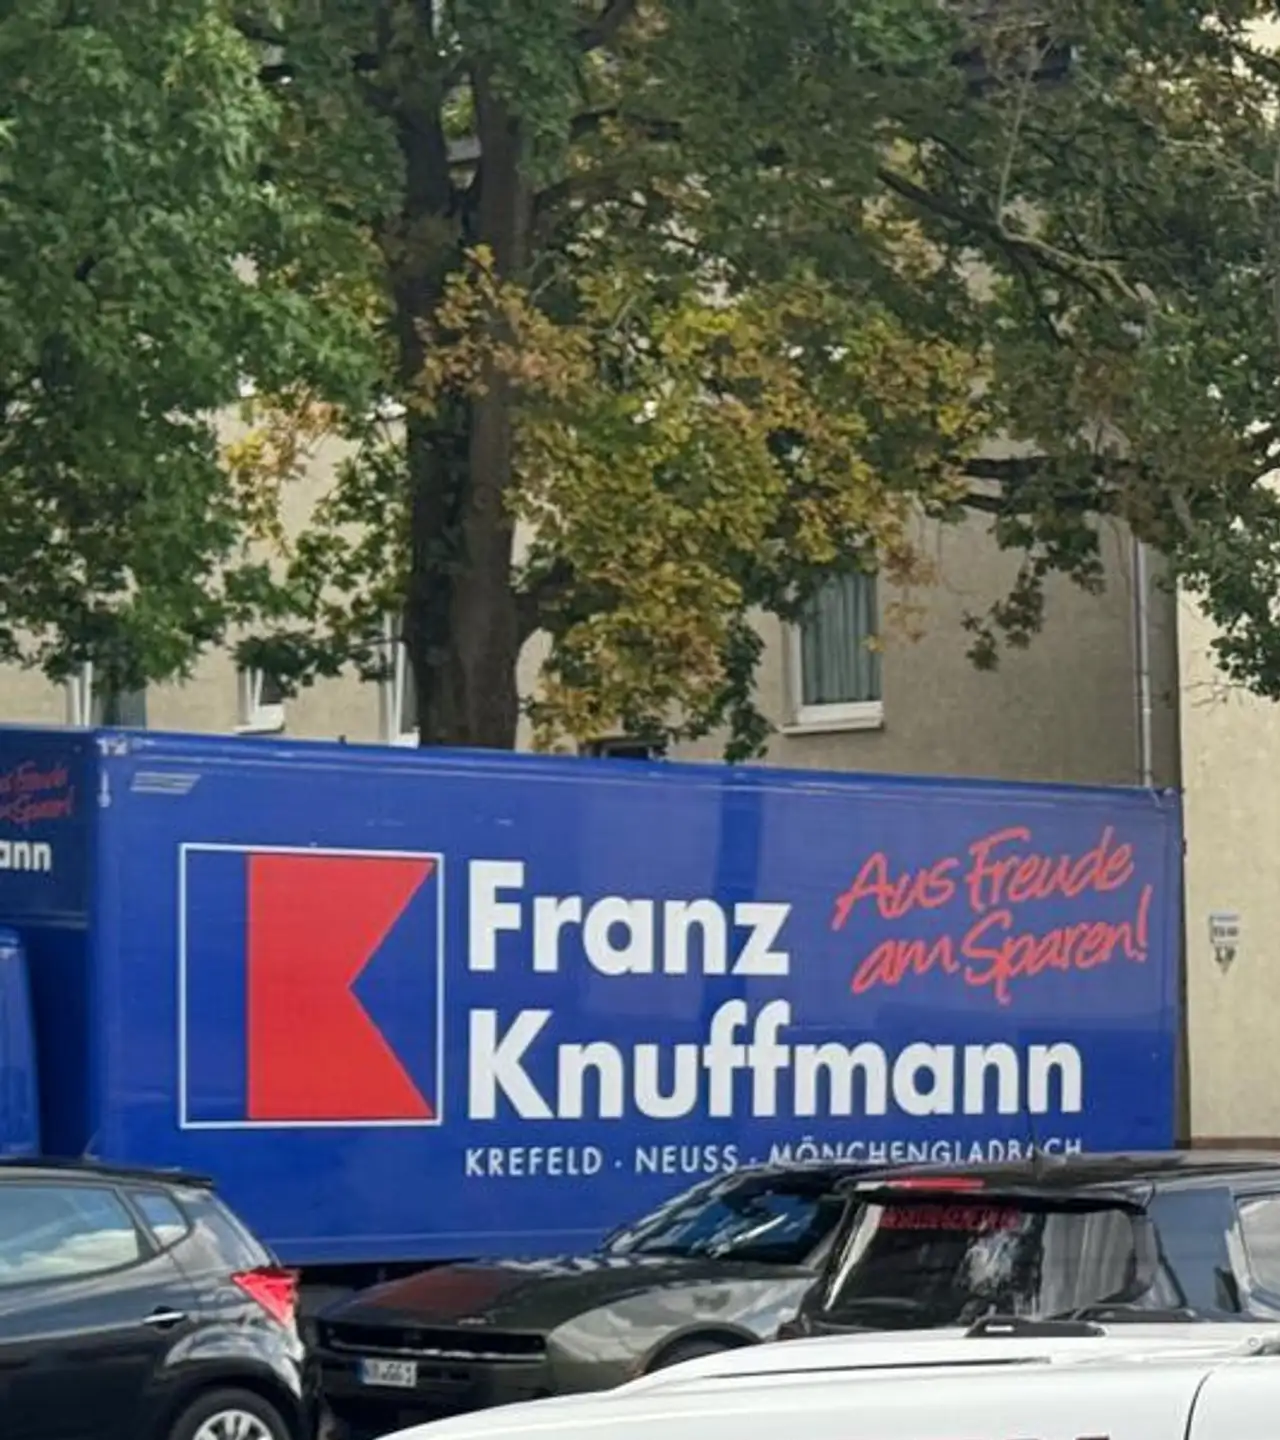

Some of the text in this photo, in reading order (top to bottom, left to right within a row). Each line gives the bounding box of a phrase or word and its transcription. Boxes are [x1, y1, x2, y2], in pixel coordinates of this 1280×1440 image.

[468, 858, 792, 977] Franz
[832, 826, 1135, 931] Aus Freude
[852, 884, 1153, 1005] am Sparen!
[468, 999, 1083, 1120] Knuffmann
[465, 1146, 602, 1177] KREFELD
[634, 1144, 740, 1173] NEUSS
